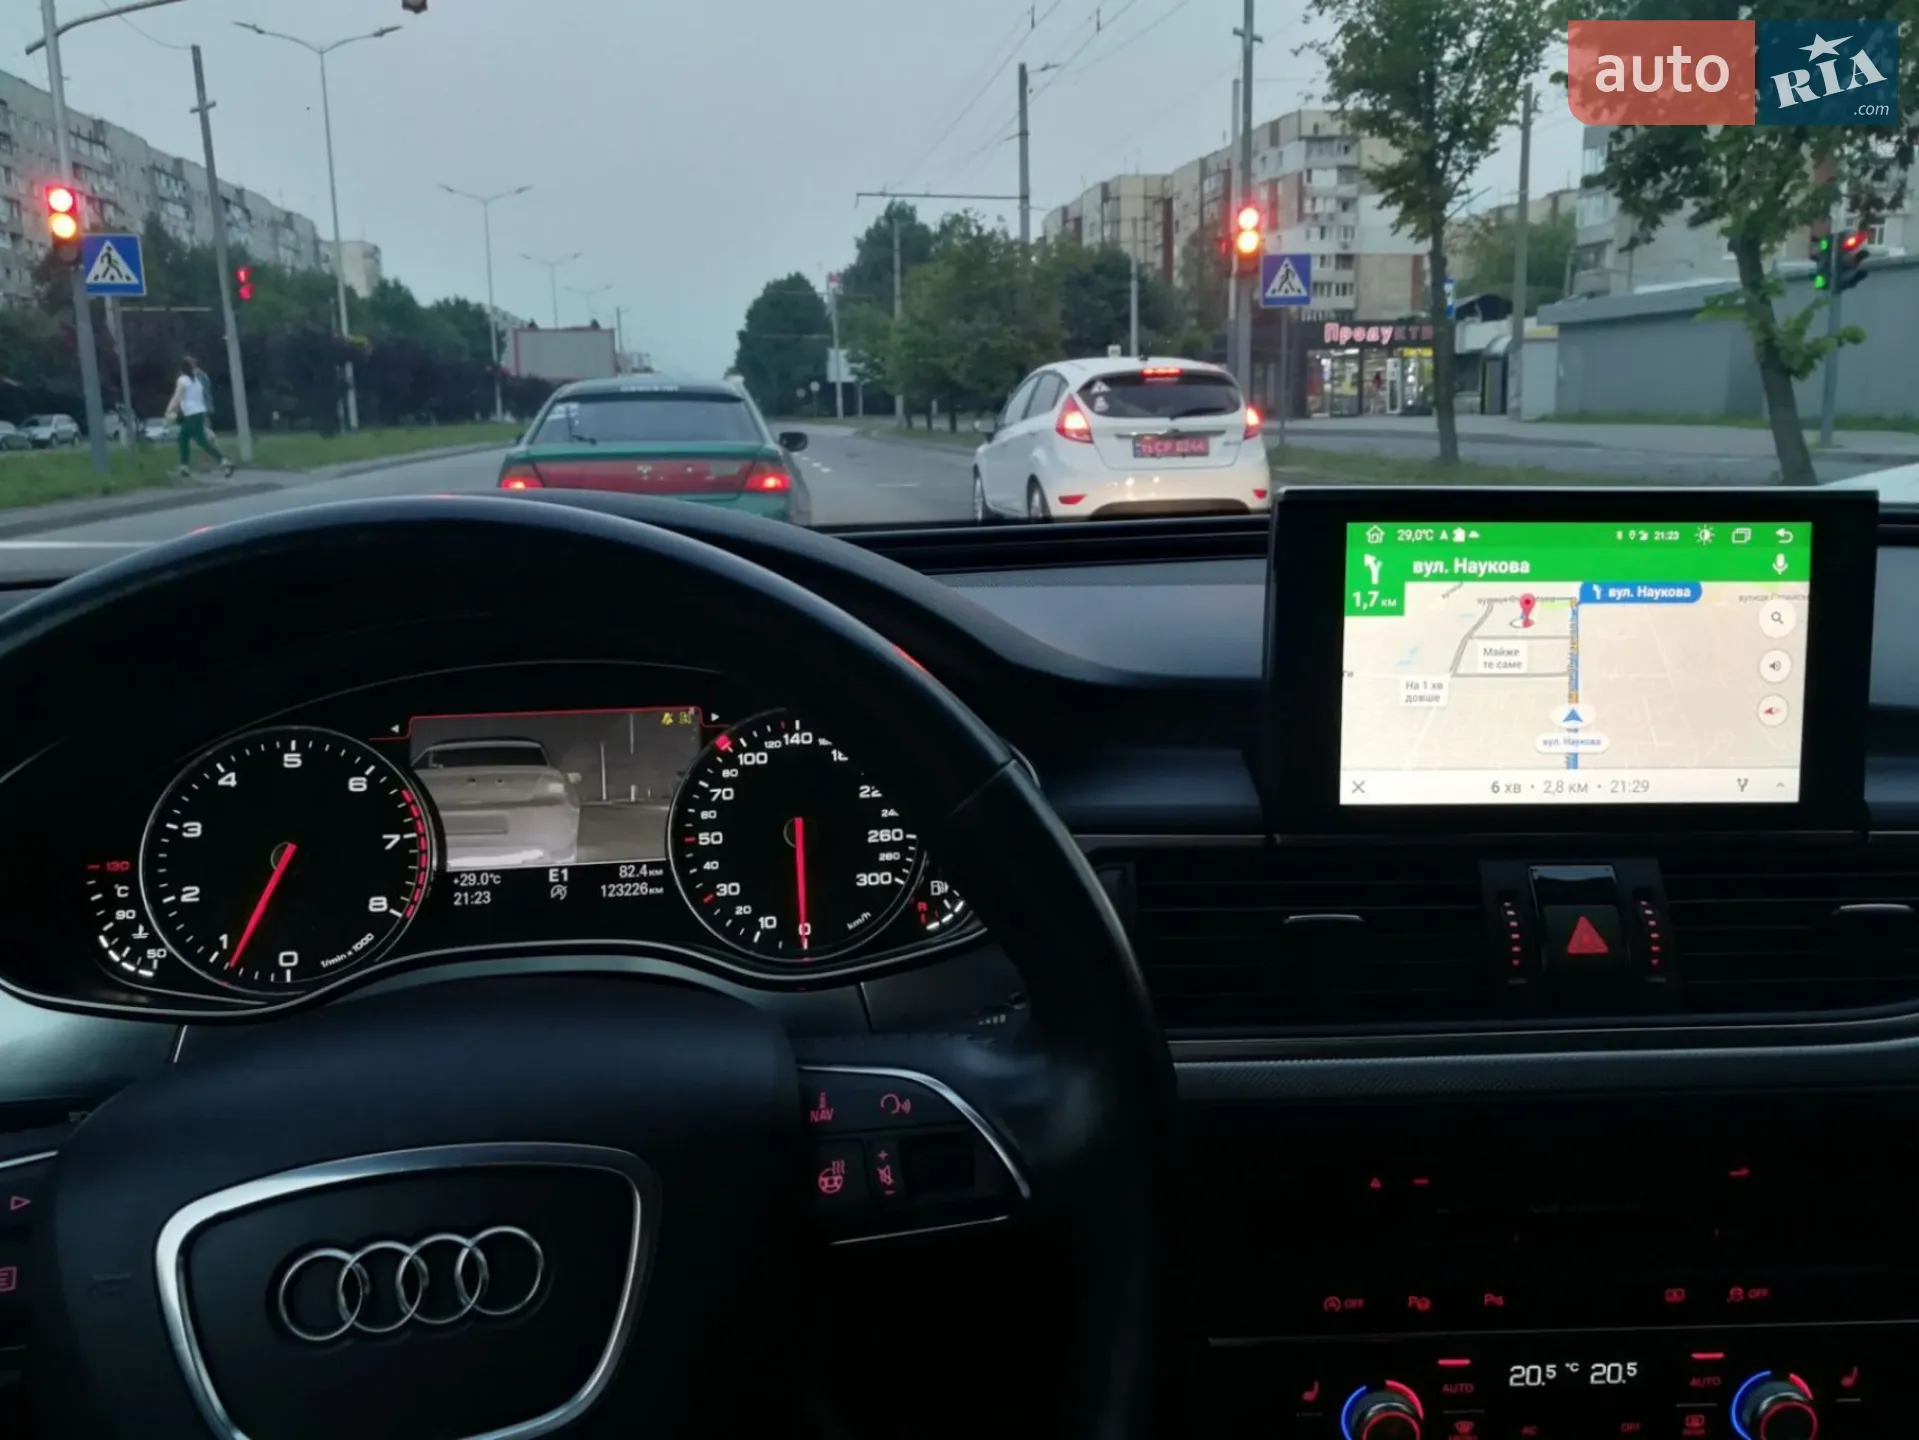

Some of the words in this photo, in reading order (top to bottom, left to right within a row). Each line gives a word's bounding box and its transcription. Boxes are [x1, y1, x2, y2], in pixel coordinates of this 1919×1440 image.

[1412, 561, 1449, 578] вул.
[1454, 557, 1531, 577] Наукова
[1608, 586, 1634, 600] вул.
[1637, 585, 1692, 599] Наукова
[1352, 591, 1380, 611] 1,7
[1381, 598, 1397, 607] км
[1483, 647, 1521, 658] Майже
[1483, 661, 1494, 669] те
[1496, 661, 1523, 669] саме
[1405, 681, 1421, 691] На
[1422, 681, 1428, 691] 1
[1431, 683, 1444, 691] хв
[1404, 693, 1441, 703] довше
[763, 735, 783, 749] 120
[782, 730, 813, 746] 140
[283, 749, 302, 768] 5
[737, 751, 768, 766] 100
[217, 771, 237, 788] 4
[721, 768, 739, 778] 80
[348, 773, 368, 792] 6
[1491, 781, 1500, 794] 6
[1504, 783, 1522, 793] хв
[1543, 780, 1565, 795] 2,8
[1568, 782, 1589, 793] км
[1609, 780, 1650, 793] 21:29
[709, 786, 734, 802] 70
[700, 809, 717, 820] 60
[182, 821, 202, 838] 3
[867, 828, 904, 843] 260
[382, 834, 401, 850] 7
[698, 831, 723, 846] 50
[105, 860, 130, 872] 130
[703, 860, 720, 870] 40
[548, 868, 569, 883] E1
[856, 873, 892, 887] 300
[180, 886, 200, 903] 2
[715, 882, 741, 897] 30
[368, 896, 388, 913] 8
[453, 890, 492, 906] 21:23
[115, 908, 136, 920] 90
[735, 905, 752, 916] 20
[758, 915, 777, 931] 10
[847, 911, 871, 930] km/h
[219, 933, 229, 950] 1
[351, 932, 375, 952] 1000
[146, 947, 168, 959] 50
[278, 950, 299, 967] 0
[810, 1108, 834, 1122] NAV
[1509, 1364, 1557, 1387] 20.5
[1590, 1362, 1638, 1385] 20.5
[1689, 1375, 1722, 1388] AUTO
[1441, 1382, 1475, 1394] AUTO
[1619, 1421, 1642, 1433] OFF
